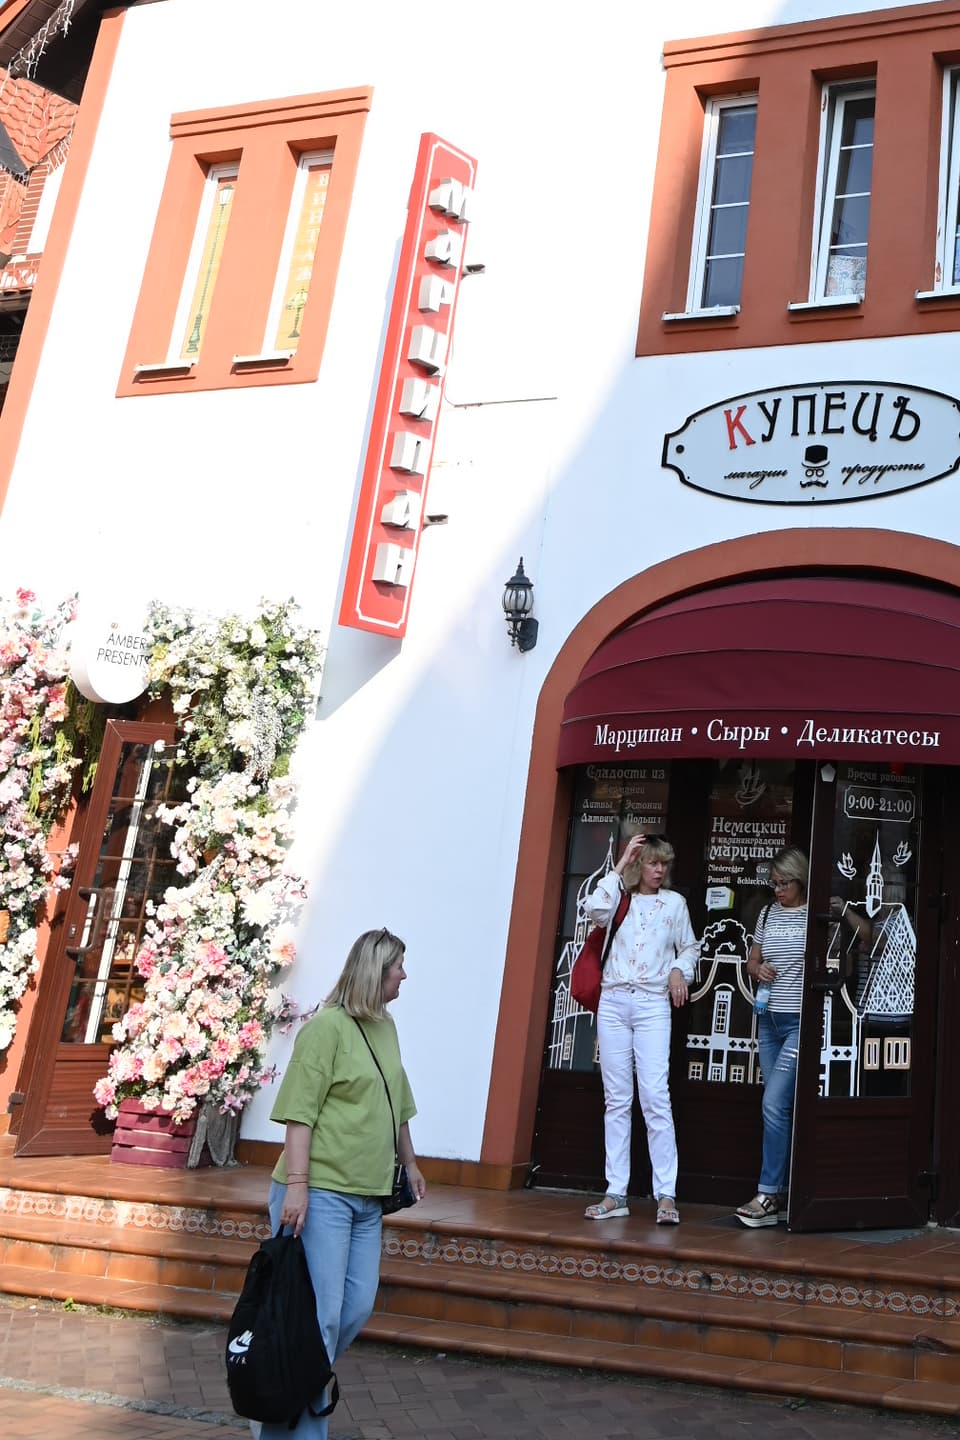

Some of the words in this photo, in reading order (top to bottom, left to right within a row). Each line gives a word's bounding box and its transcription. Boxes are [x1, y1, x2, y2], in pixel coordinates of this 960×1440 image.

[371, 176, 471, 587] МАРЦИПАН
[724, 391, 921, 450] КУПЕЦЪ
[723, 467, 788, 489] магазин
[841, 462, 926, 485] продукты
[106, 632, 147, 650] AMBER
[593, 723, 683, 752] Марципан
[706, 719, 771, 750] Сыры
[797, 720, 940, 747] Деликатесы
[847, 794, 912, 814] 9:00-21:00
[711, 816, 787, 836] Немецкий
